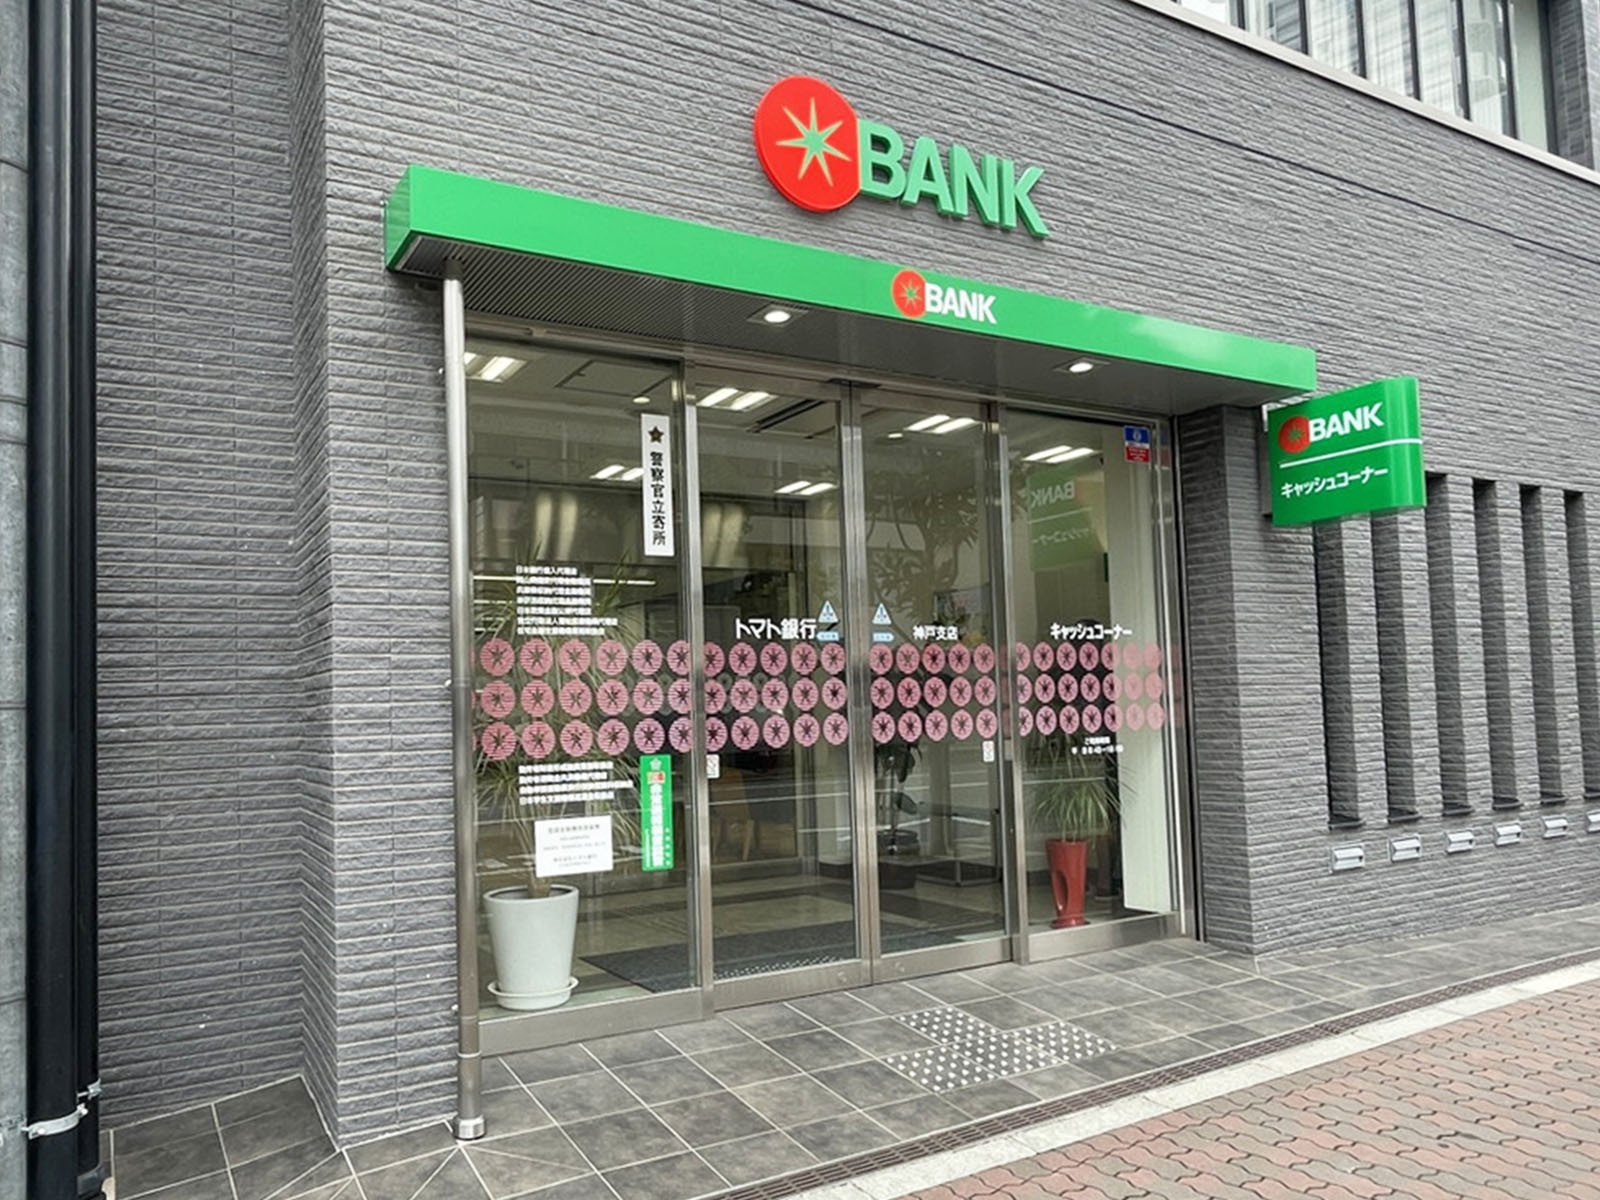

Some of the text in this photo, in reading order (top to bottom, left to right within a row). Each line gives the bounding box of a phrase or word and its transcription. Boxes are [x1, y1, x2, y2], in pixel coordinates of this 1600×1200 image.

[857, 119, 1050, 236] BANK
[925, 283, 997, 324] BANK
[1308, 402, 1384, 442] BANK
[650, 451, 666, 546] 警察官立寄所
[1281, 466, 1388, 499] キャッシュコーナー
[735, 618, 817, 640] トマト銀行
[912, 625, 959, 641] 神戸支店
[1050, 622, 1133, 640] キャッシュコーナー
